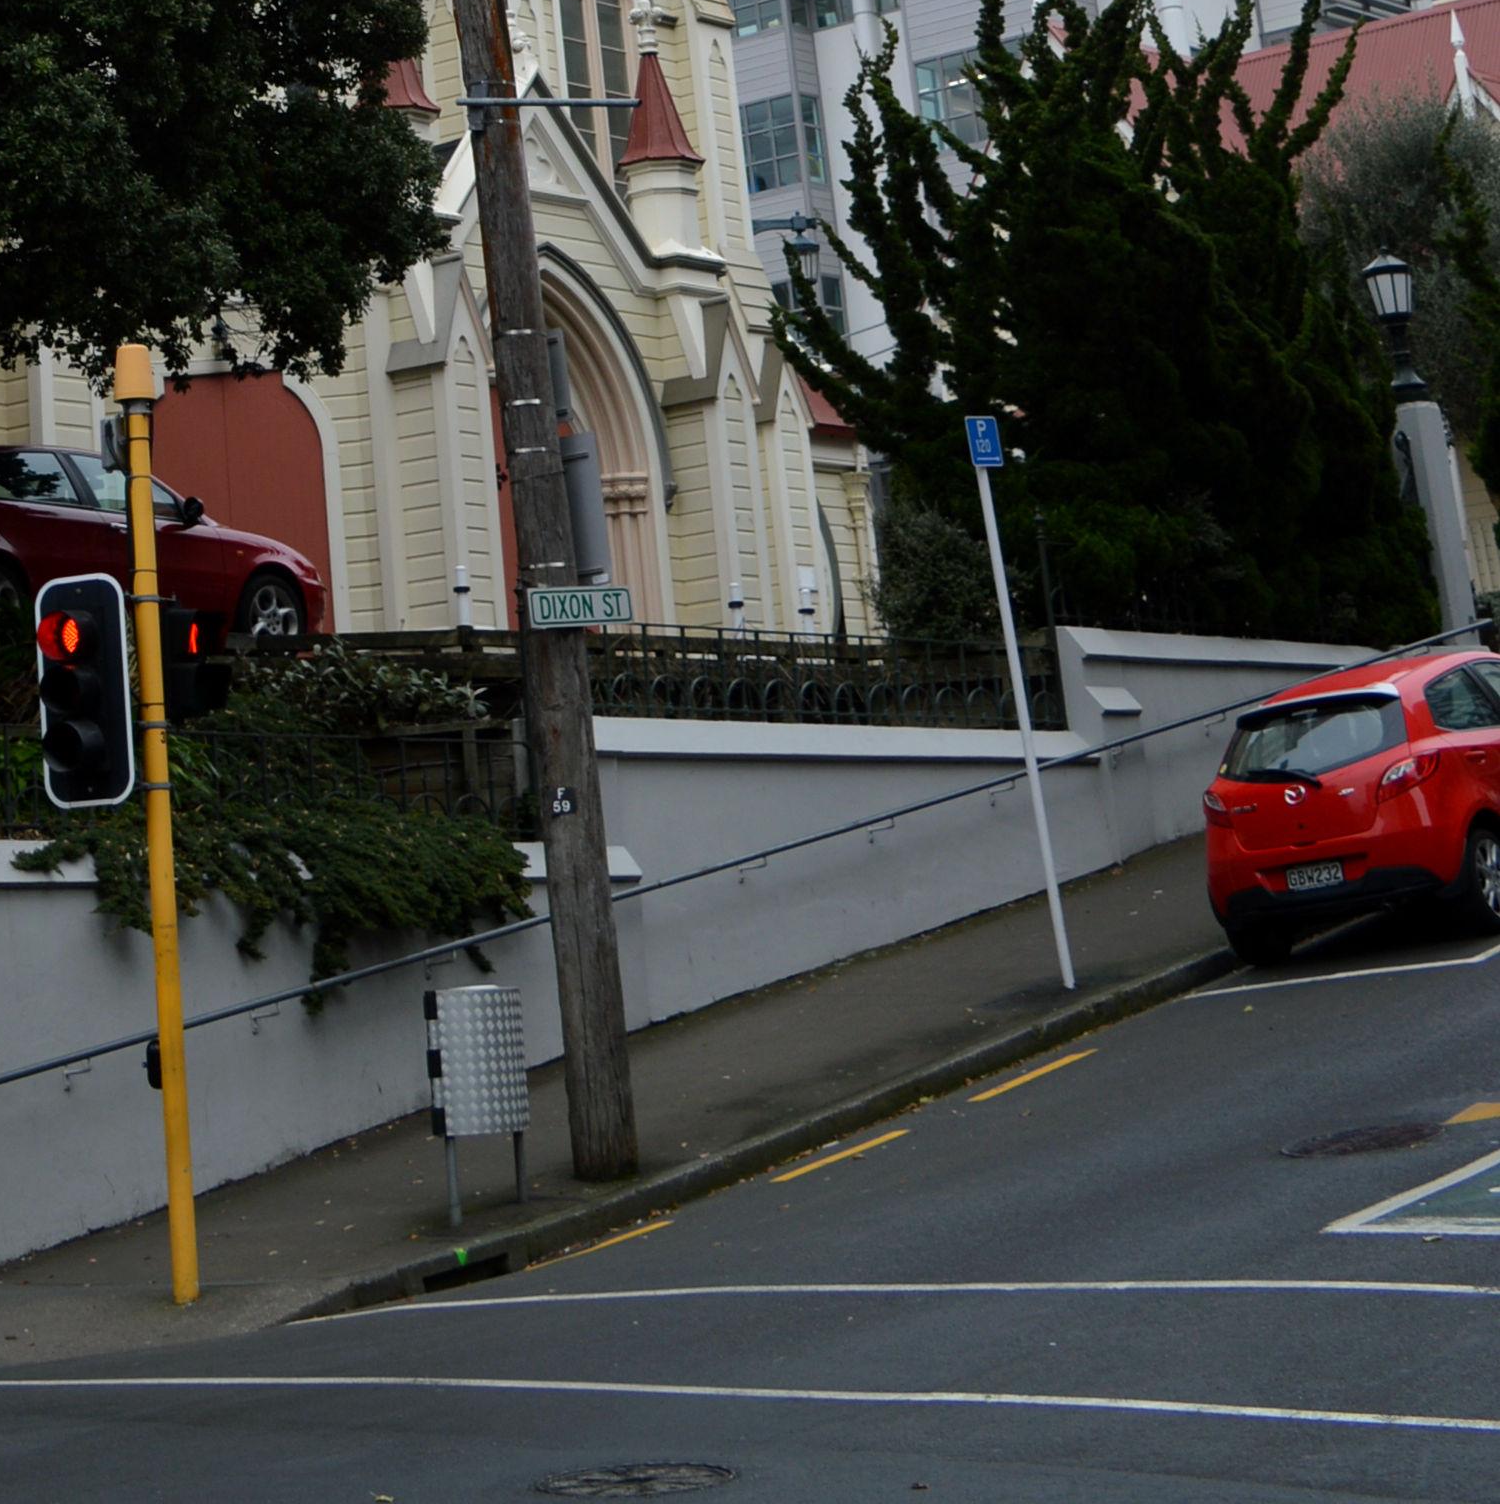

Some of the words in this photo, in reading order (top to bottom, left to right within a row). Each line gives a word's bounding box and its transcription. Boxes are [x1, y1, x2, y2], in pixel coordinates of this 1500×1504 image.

[976, 420, 987, 438] P
[976, 438, 992, 453] 120
[539, 594, 595, 619] DIXON
[602, 593, 622, 617] ST
[556, 786, 567, 800] F
[552, 799, 571, 814] 59
[1288, 863, 1341, 887] GBW232
